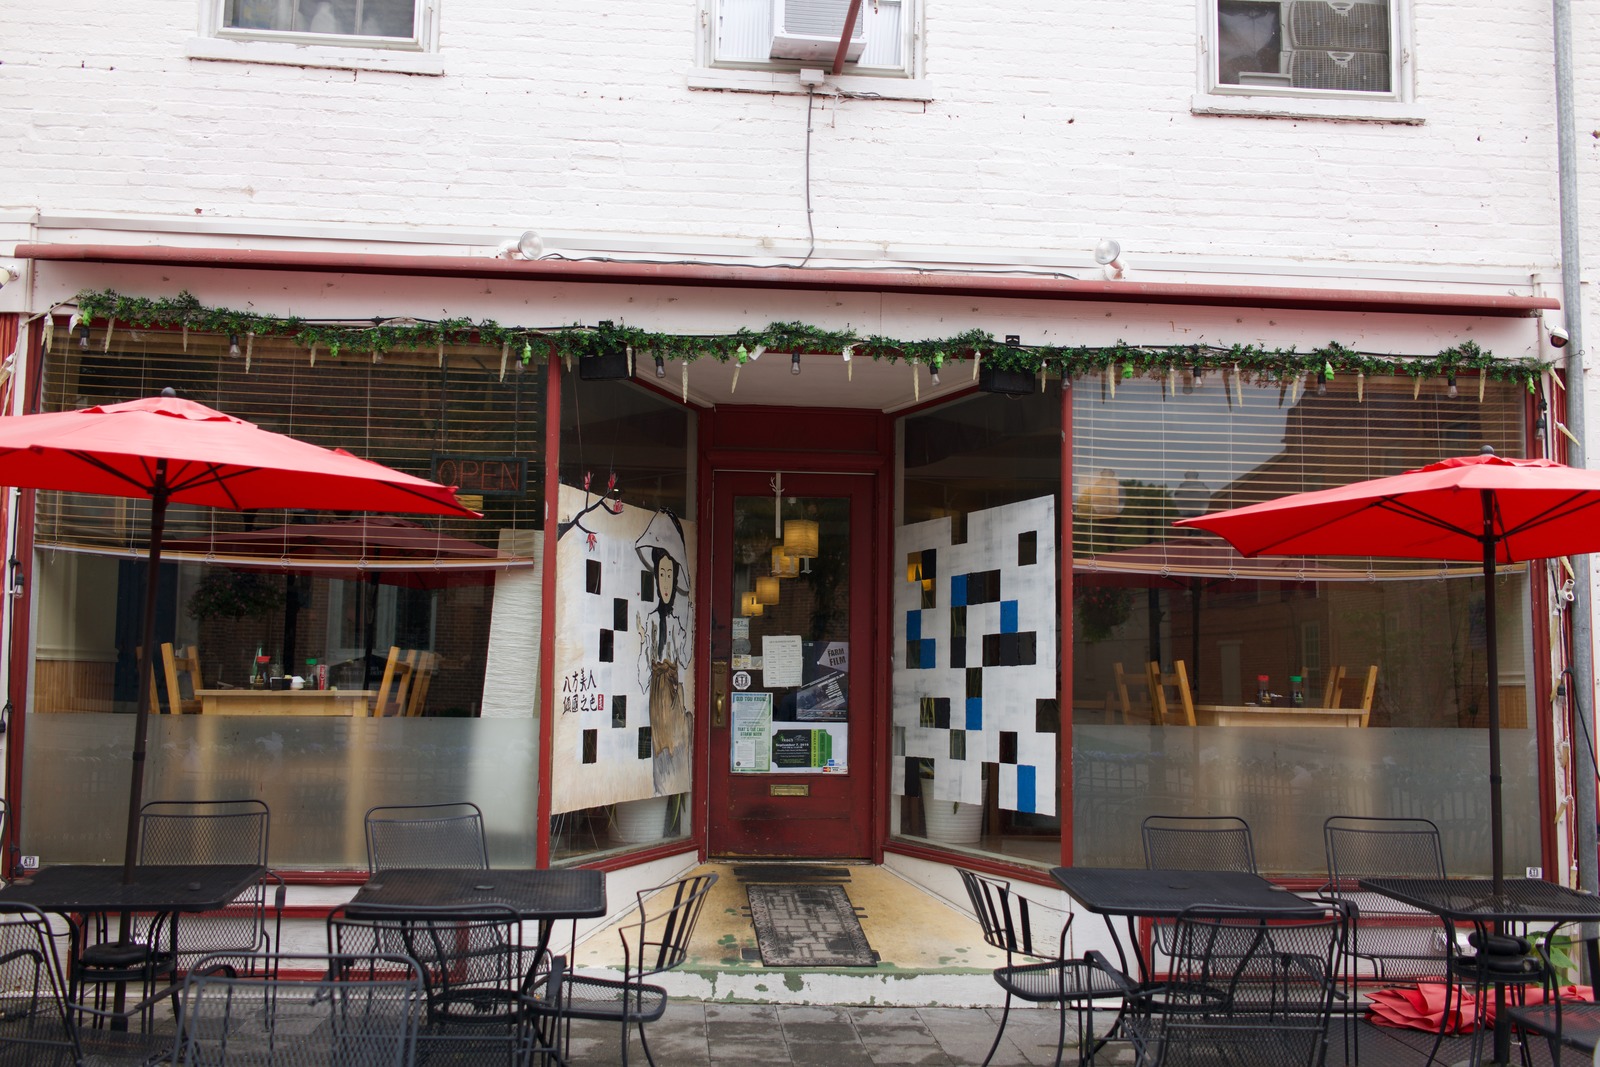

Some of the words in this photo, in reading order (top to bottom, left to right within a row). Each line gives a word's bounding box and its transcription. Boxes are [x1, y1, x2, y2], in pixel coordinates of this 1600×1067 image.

[438, 460, 519, 490] OPEN
[827, 648, 844, 657] FARM
[829, 656, 846, 666] FILM
[563, 667, 597, 692] 八方美人
